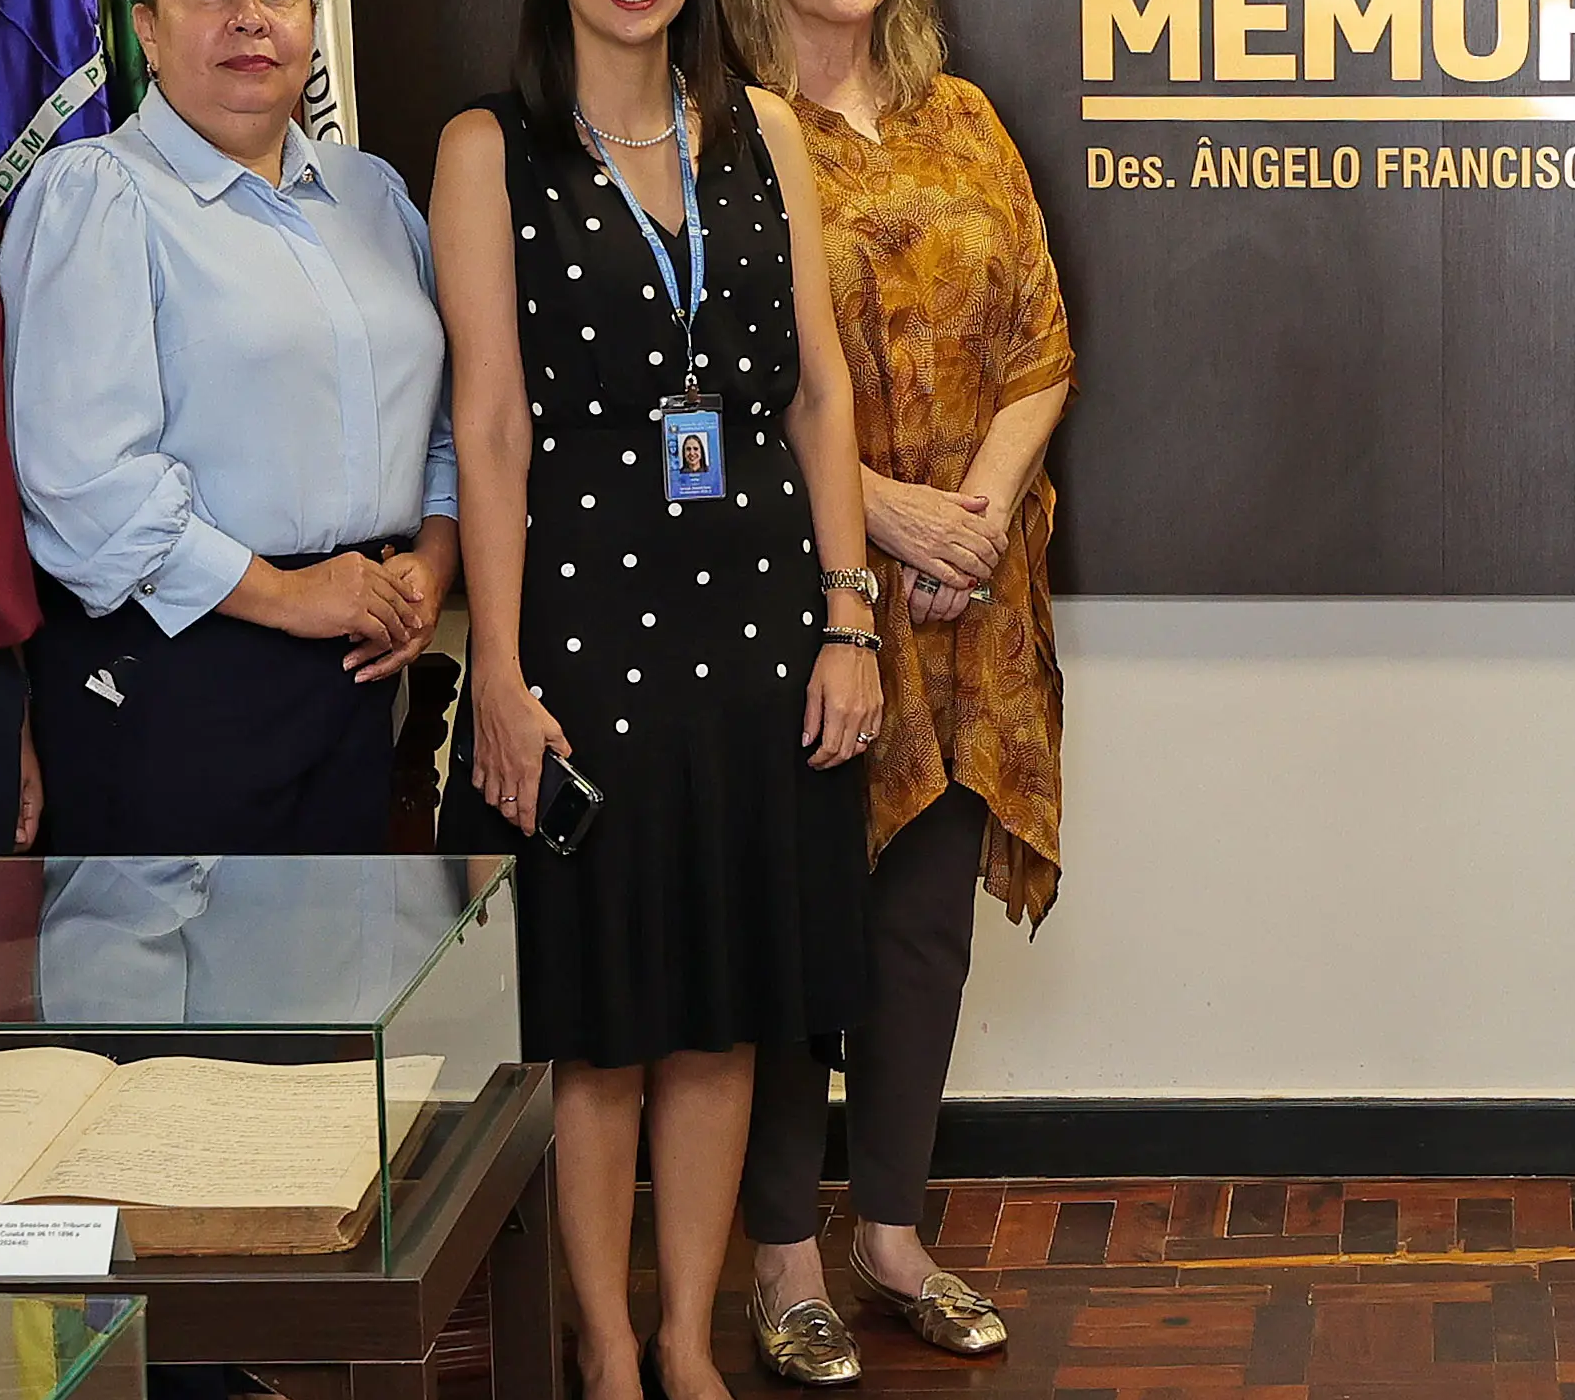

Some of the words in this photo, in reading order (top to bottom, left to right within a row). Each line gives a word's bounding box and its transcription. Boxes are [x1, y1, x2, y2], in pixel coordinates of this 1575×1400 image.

[51, 94, 74, 117] E
[1087, 146, 1177, 190] Des.
[1191, 136, 1361, 190] ÂNGELO
